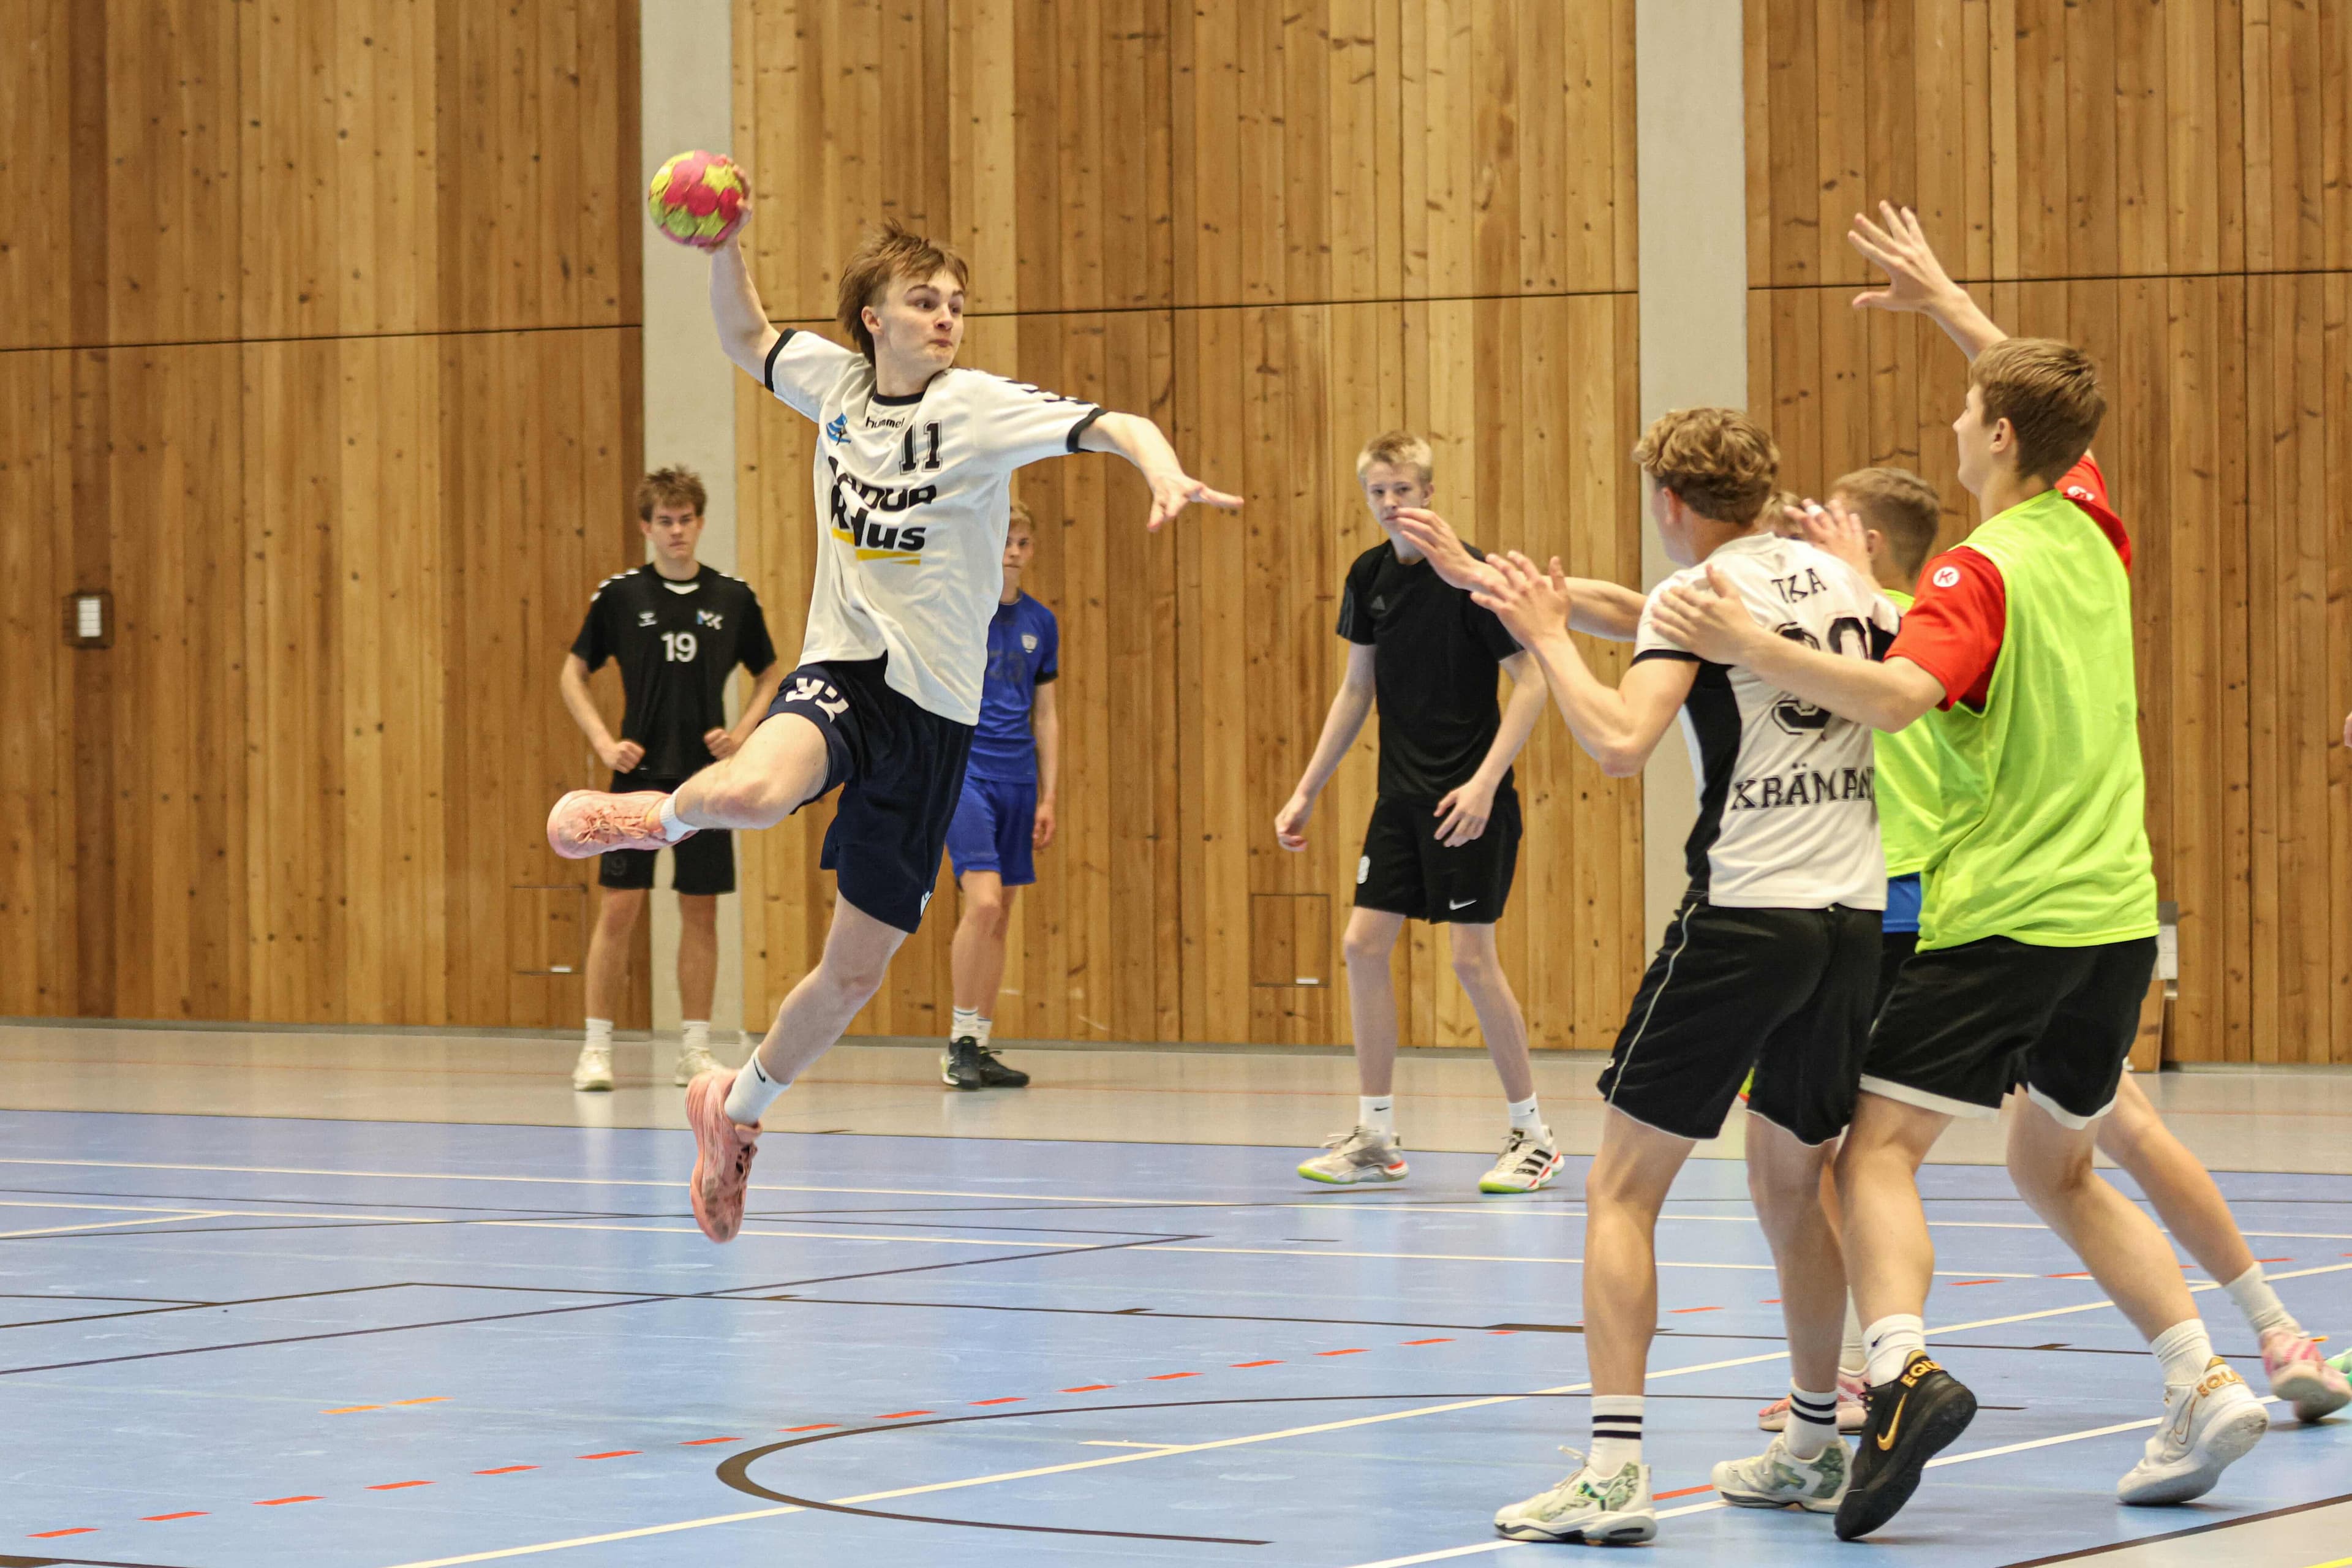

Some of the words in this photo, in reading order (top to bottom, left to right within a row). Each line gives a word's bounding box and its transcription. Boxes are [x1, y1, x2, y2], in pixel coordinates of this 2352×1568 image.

[865, 417, 905, 429] hummel
[899, 419, 943, 475] 11
[660, 631, 697, 662] 19
